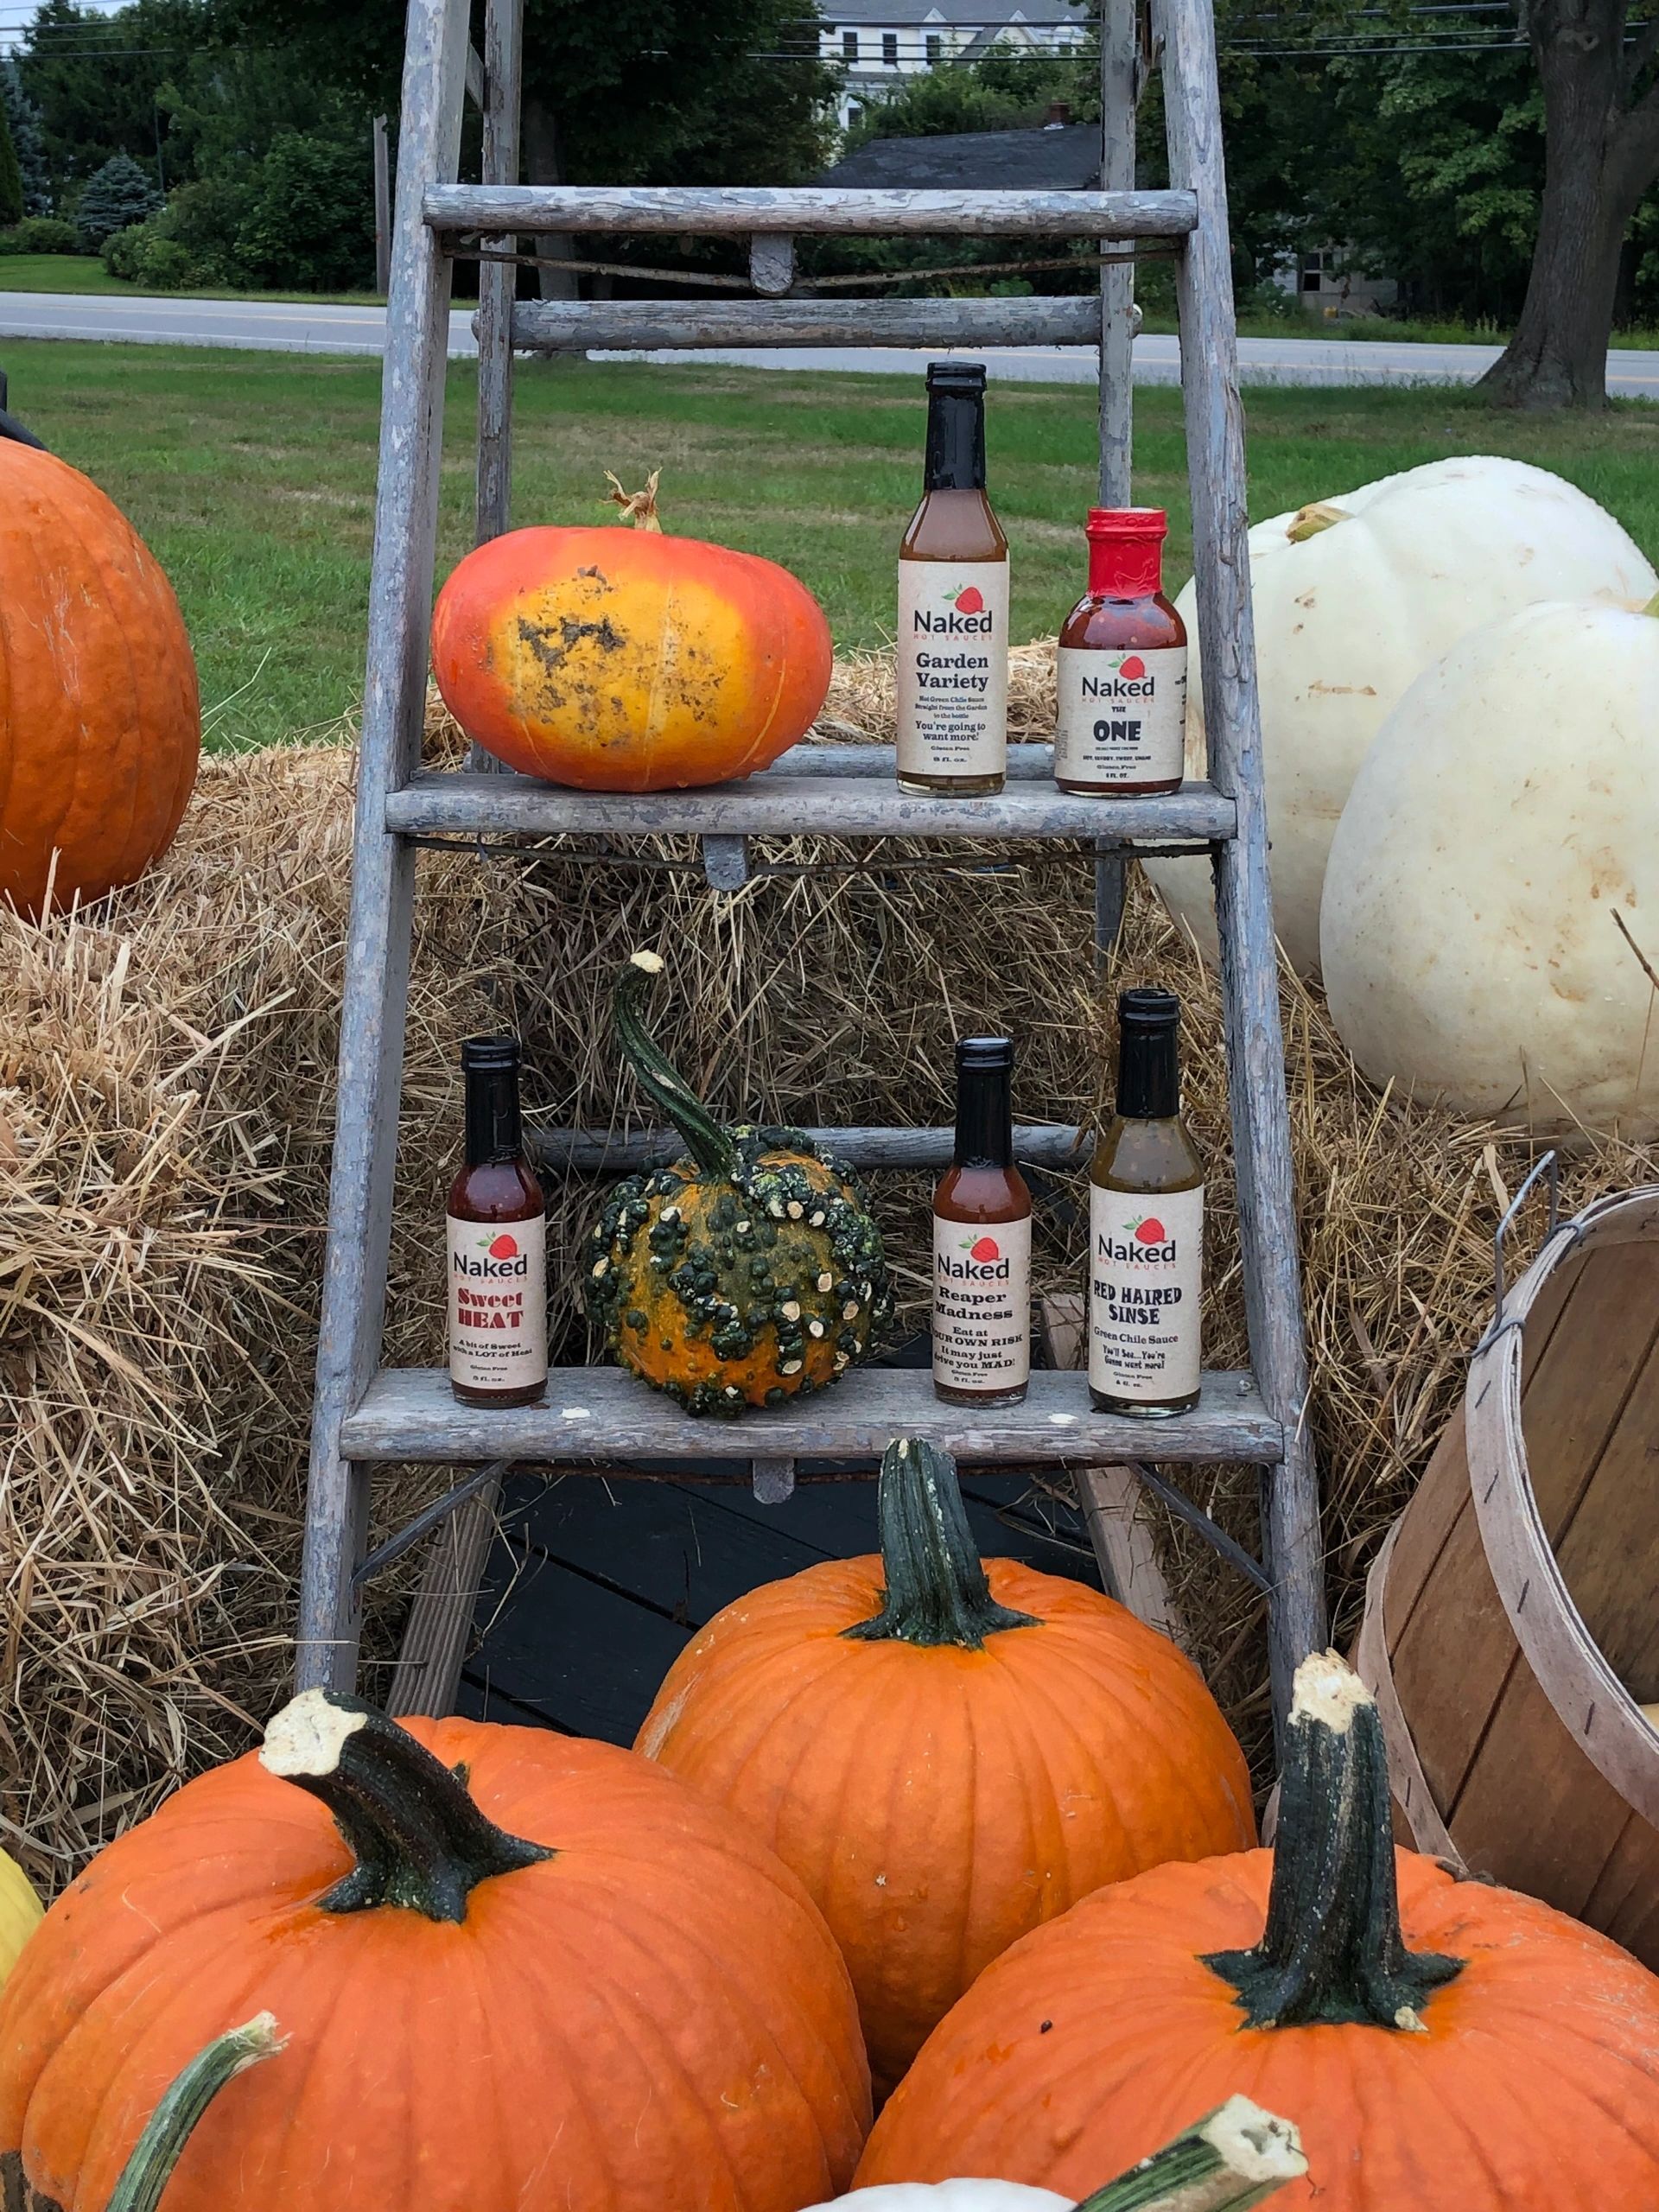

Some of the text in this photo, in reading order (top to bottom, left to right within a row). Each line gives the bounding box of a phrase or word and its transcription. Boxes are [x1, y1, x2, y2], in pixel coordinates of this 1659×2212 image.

[914, 609, 992, 633] Naked
[916, 652, 989, 669] Garden
[917, 671, 989, 692] Variety
[1082, 677, 1154, 696] Naked
[915, 721, 947, 730] You're
[948, 722, 976, 733] going
[1093, 720, 1141, 741] ONE
[1098, 1234, 1175, 1262] Naked
[454, 1251, 527, 1277] Naked
[938, 1253, 1009, 1280] Naked
[458, 1287, 523, 1307] Sweet
[939, 1286, 1007, 1306] Reaper
[1094, 1280, 1182, 1306] RED HAIRED
[458, 1308, 524, 1328] HEAT
[935, 1300, 1013, 1320] Madness
[1109, 1303, 1160, 1325] SINSE
[933, 1328, 1023, 1346] OUR OWN RISK
[952, 1326, 973, 1336] Eat
[1094, 1326, 1179, 1344] Green Chile Sauce
[950, 1349, 976, 1361] may
[978, 1351, 1002, 1361] just
[981, 1357, 1015, 1369] MAD!
